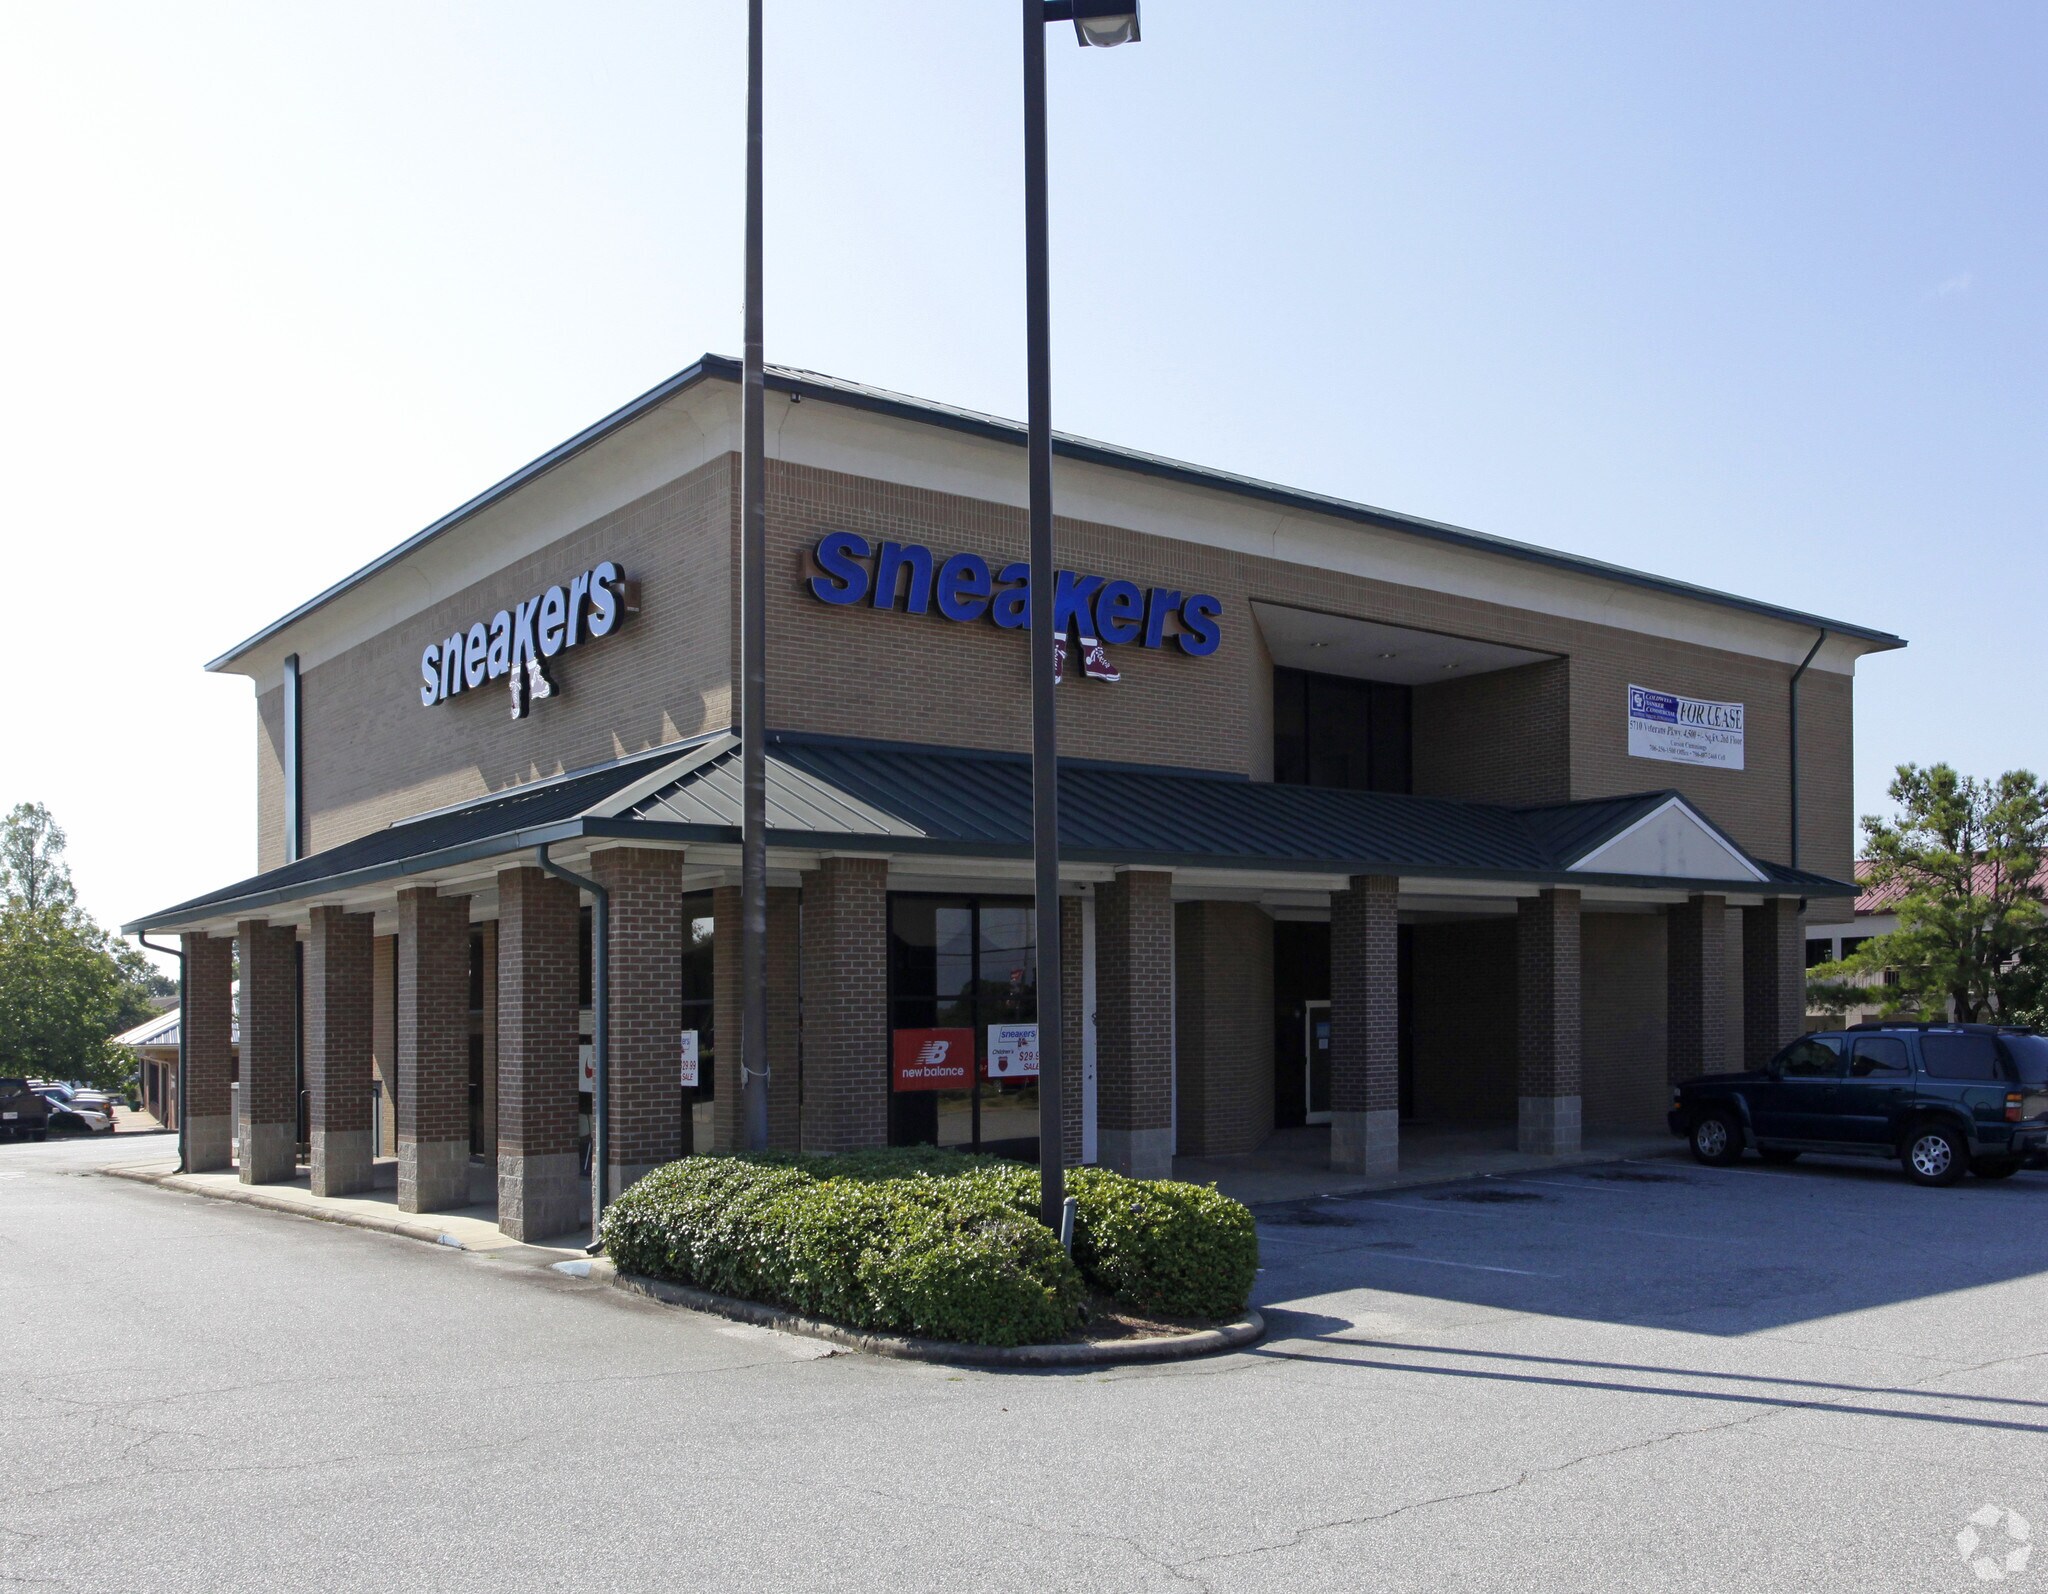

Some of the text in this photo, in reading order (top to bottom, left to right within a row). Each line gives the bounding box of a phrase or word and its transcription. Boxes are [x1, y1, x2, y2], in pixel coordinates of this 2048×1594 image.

[807, 530, 1224, 657] sneakers
[420, 560, 621, 708] sneakers
[1680, 702, 1705, 724] FOR
[1707, 706, 1742, 730] LEASE
[1629, 720, 1643, 730] 5710
[1001, 1030, 1036, 1039] sneakers
[682, 1073, 693, 1081] SALE
[902, 1065, 964, 1078] new balance
